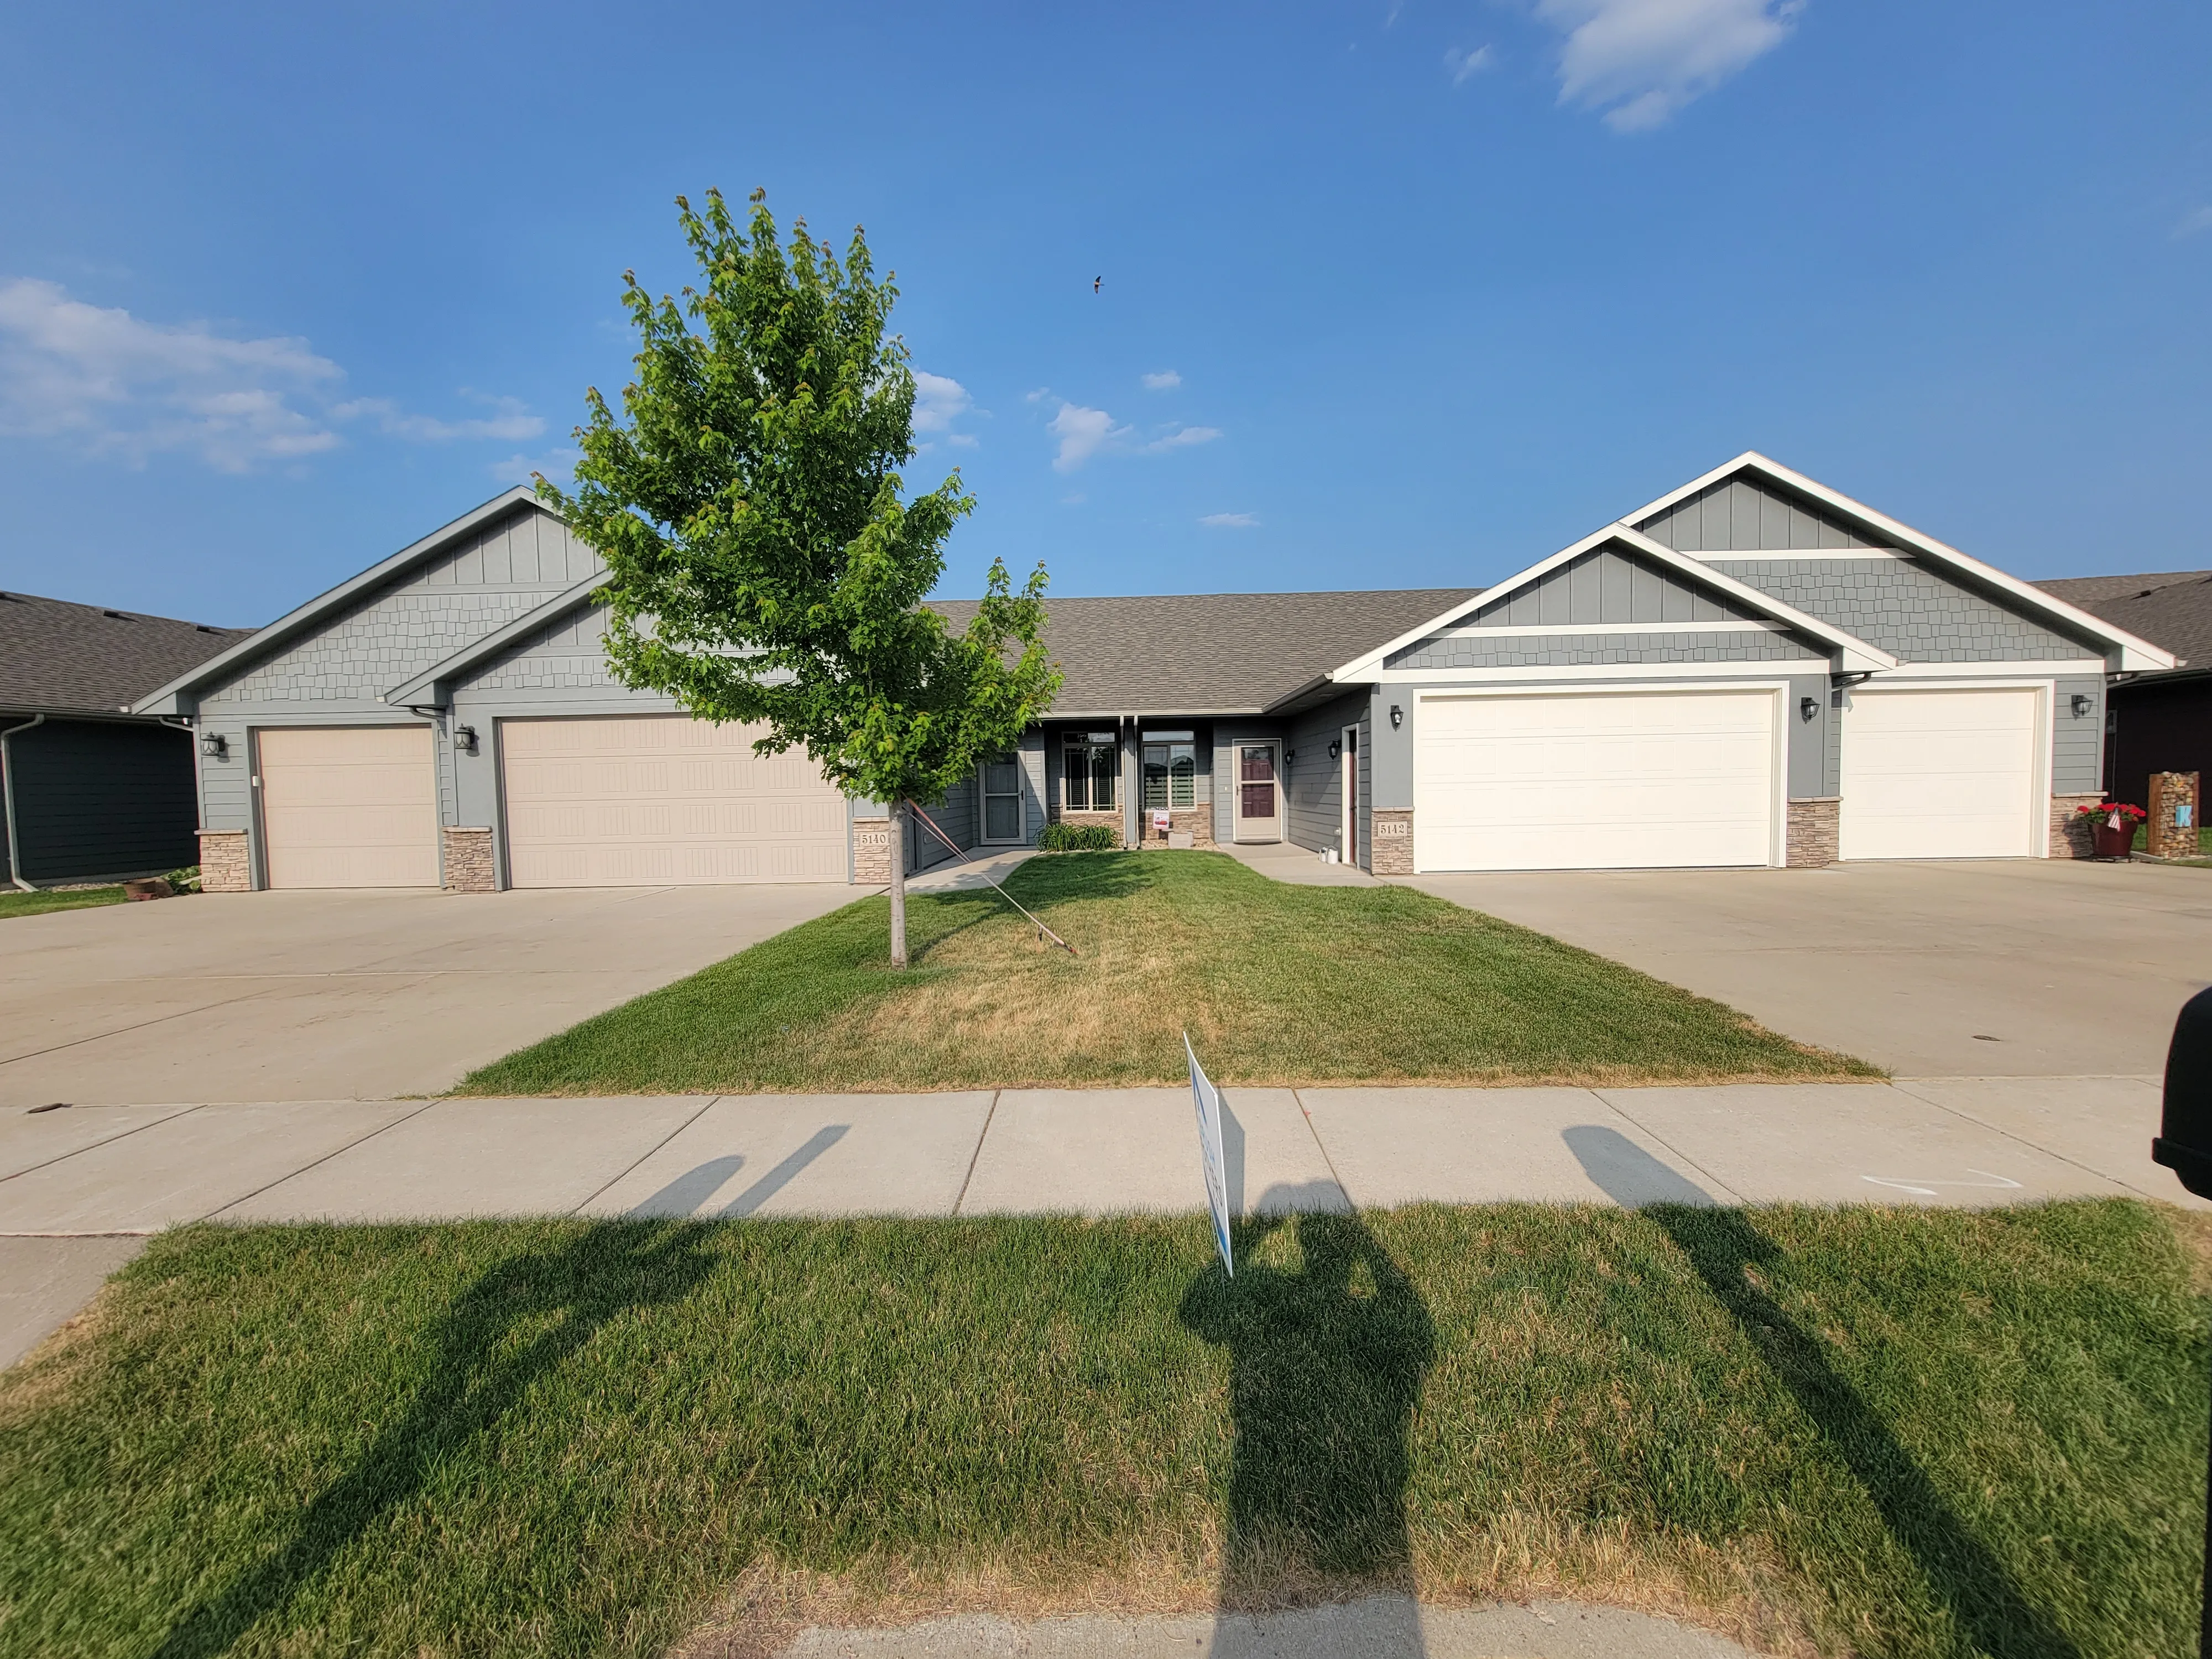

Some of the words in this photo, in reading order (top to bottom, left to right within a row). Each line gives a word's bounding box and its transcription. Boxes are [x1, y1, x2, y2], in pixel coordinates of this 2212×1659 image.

[2176, 805, 2192, 827] K
[1381, 825, 1405, 834] 5142
[862, 834, 886, 844] 5140
